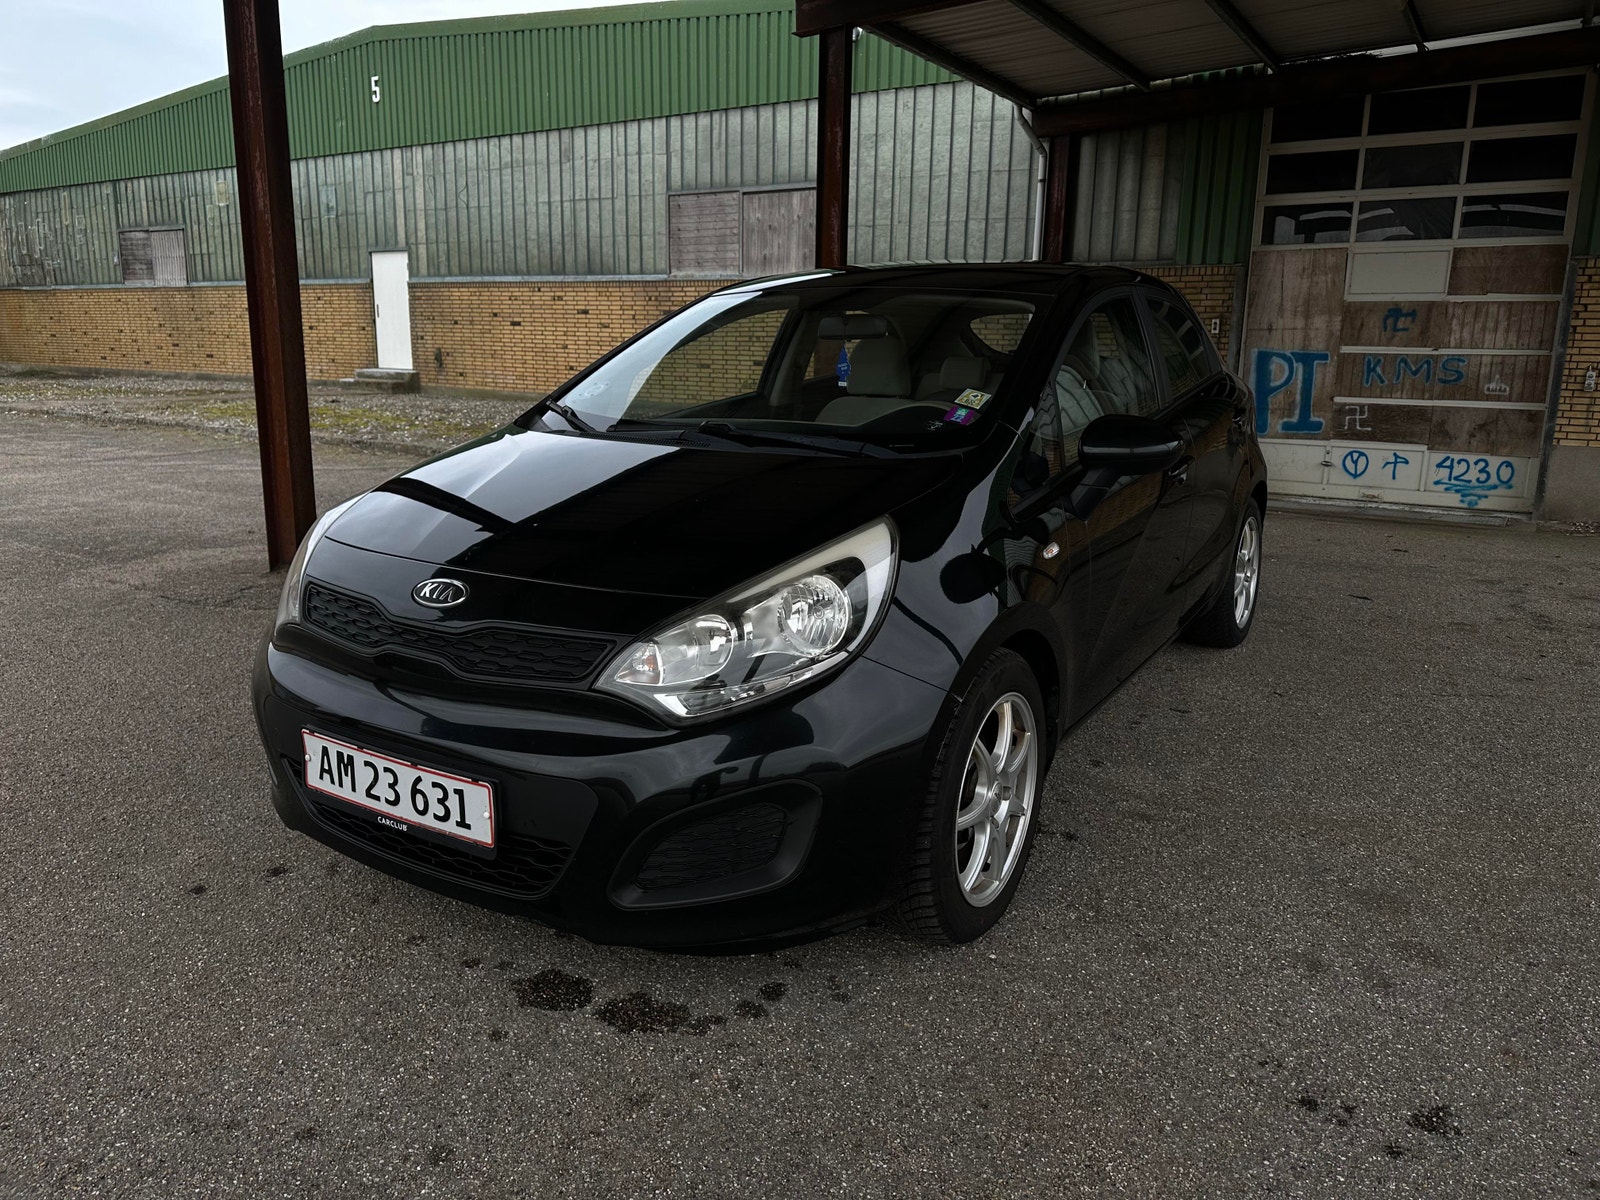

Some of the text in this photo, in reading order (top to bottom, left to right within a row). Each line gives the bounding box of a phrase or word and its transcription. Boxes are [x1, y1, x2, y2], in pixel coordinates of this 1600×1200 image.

[371, 76, 380, 103] 5
[1363, 355, 1468, 386] KMS
[1250, 348, 1331, 437] PI
[1435, 455, 1515, 484] 4230
[420, 582, 455, 602] KIA
[319, 745, 472, 831] AM 23 631
[377, 816, 408, 831] CARCLUB
